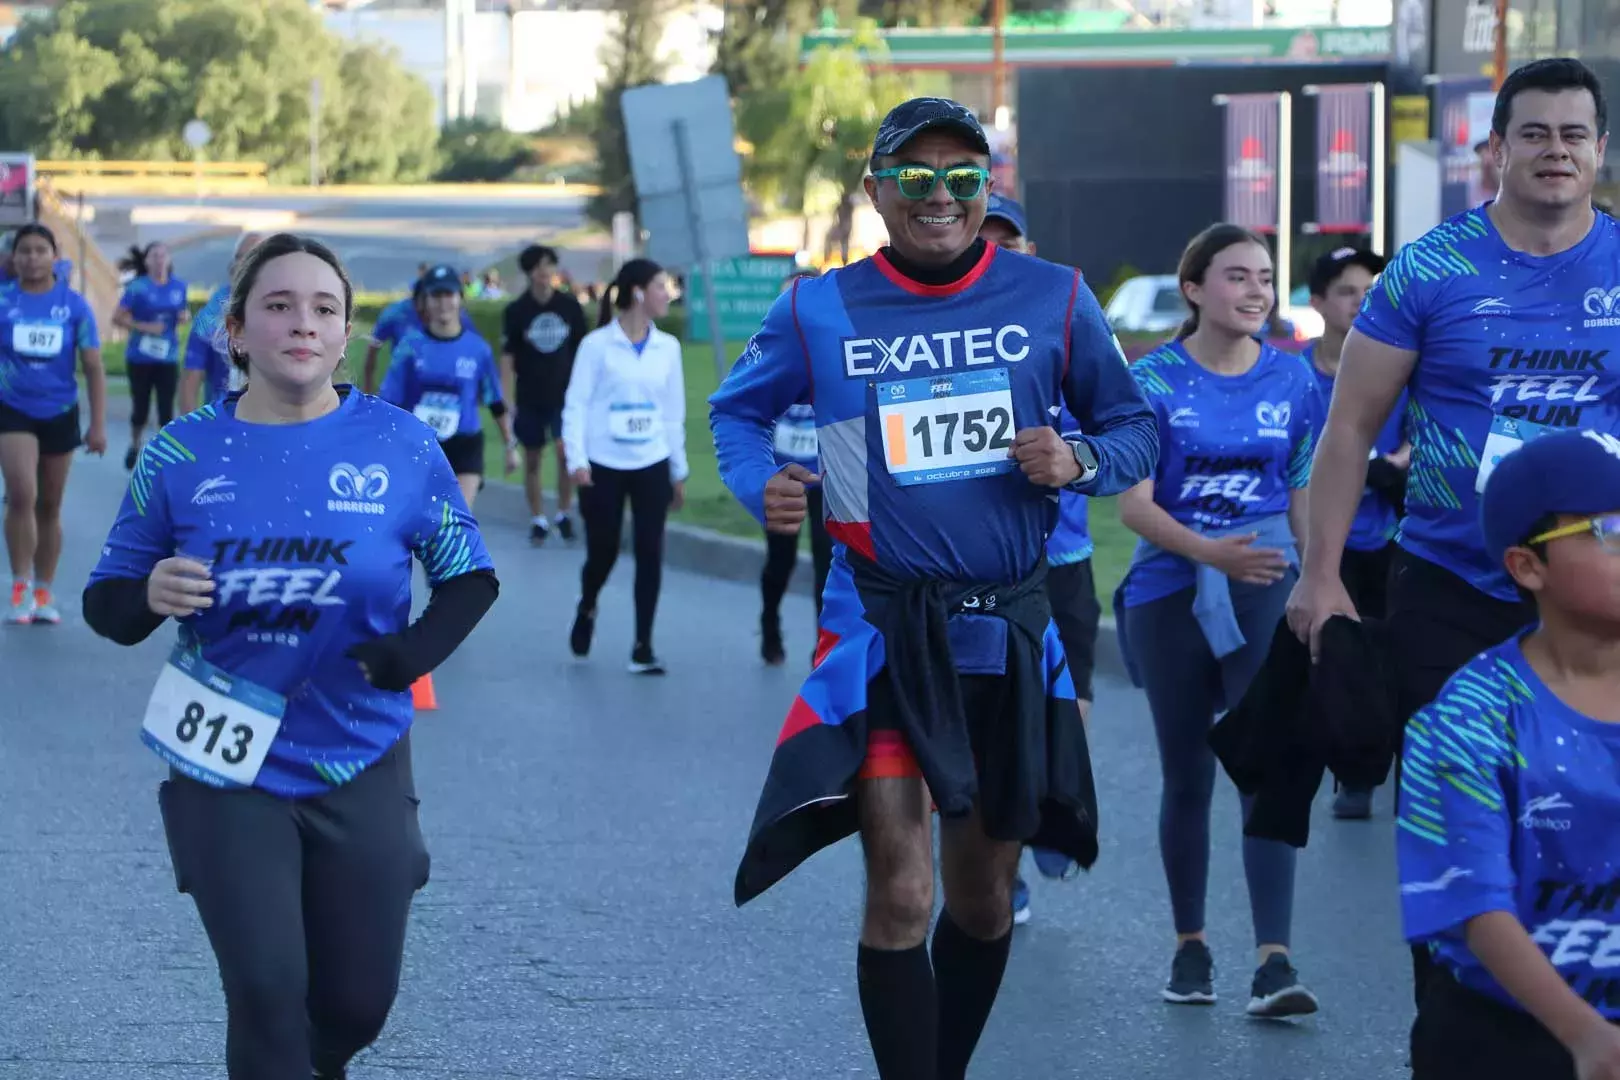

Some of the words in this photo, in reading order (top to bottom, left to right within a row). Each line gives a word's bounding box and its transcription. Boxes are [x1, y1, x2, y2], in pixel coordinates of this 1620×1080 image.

[844, 324, 1030, 376] EXATEC
[1487, 347, 1611, 371] THINK
[1488, 374, 1600, 406] FEEL
[1501, 404, 1583, 427] RUN
[912, 406, 1014, 458] 1752
[1179, 474, 1263, 502] FEEL
[327, 499, 385, 515] BORREGOS
[211, 537, 355, 566] THINK
[217, 567, 347, 608] FEEL
[176, 701, 254, 765] 813
